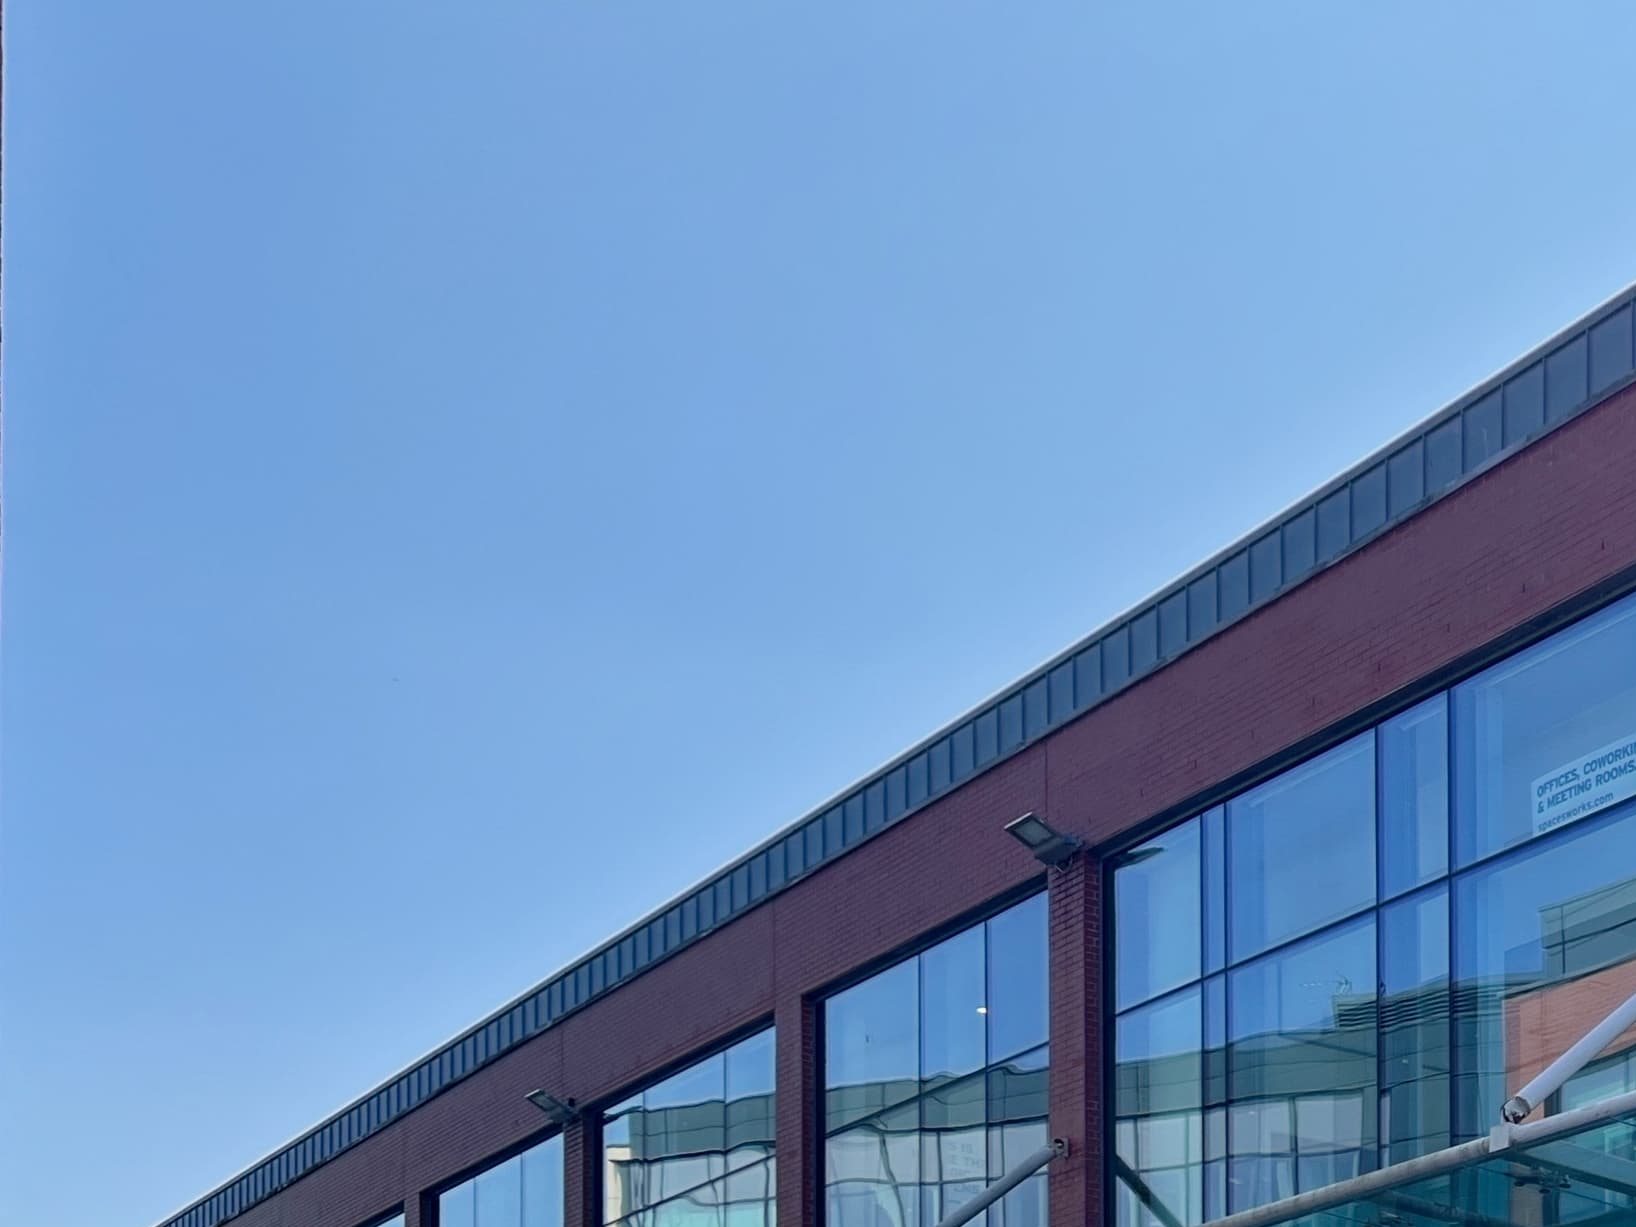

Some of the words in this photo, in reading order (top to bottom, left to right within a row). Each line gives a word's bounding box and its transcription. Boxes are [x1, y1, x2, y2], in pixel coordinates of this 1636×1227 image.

[1536, 768, 1579, 798] OFFICES,
[1537, 802, 1544, 814] &
[1547, 779, 1592, 809] MEETING
[1538, 792, 1614, 832] spacesworks.com
